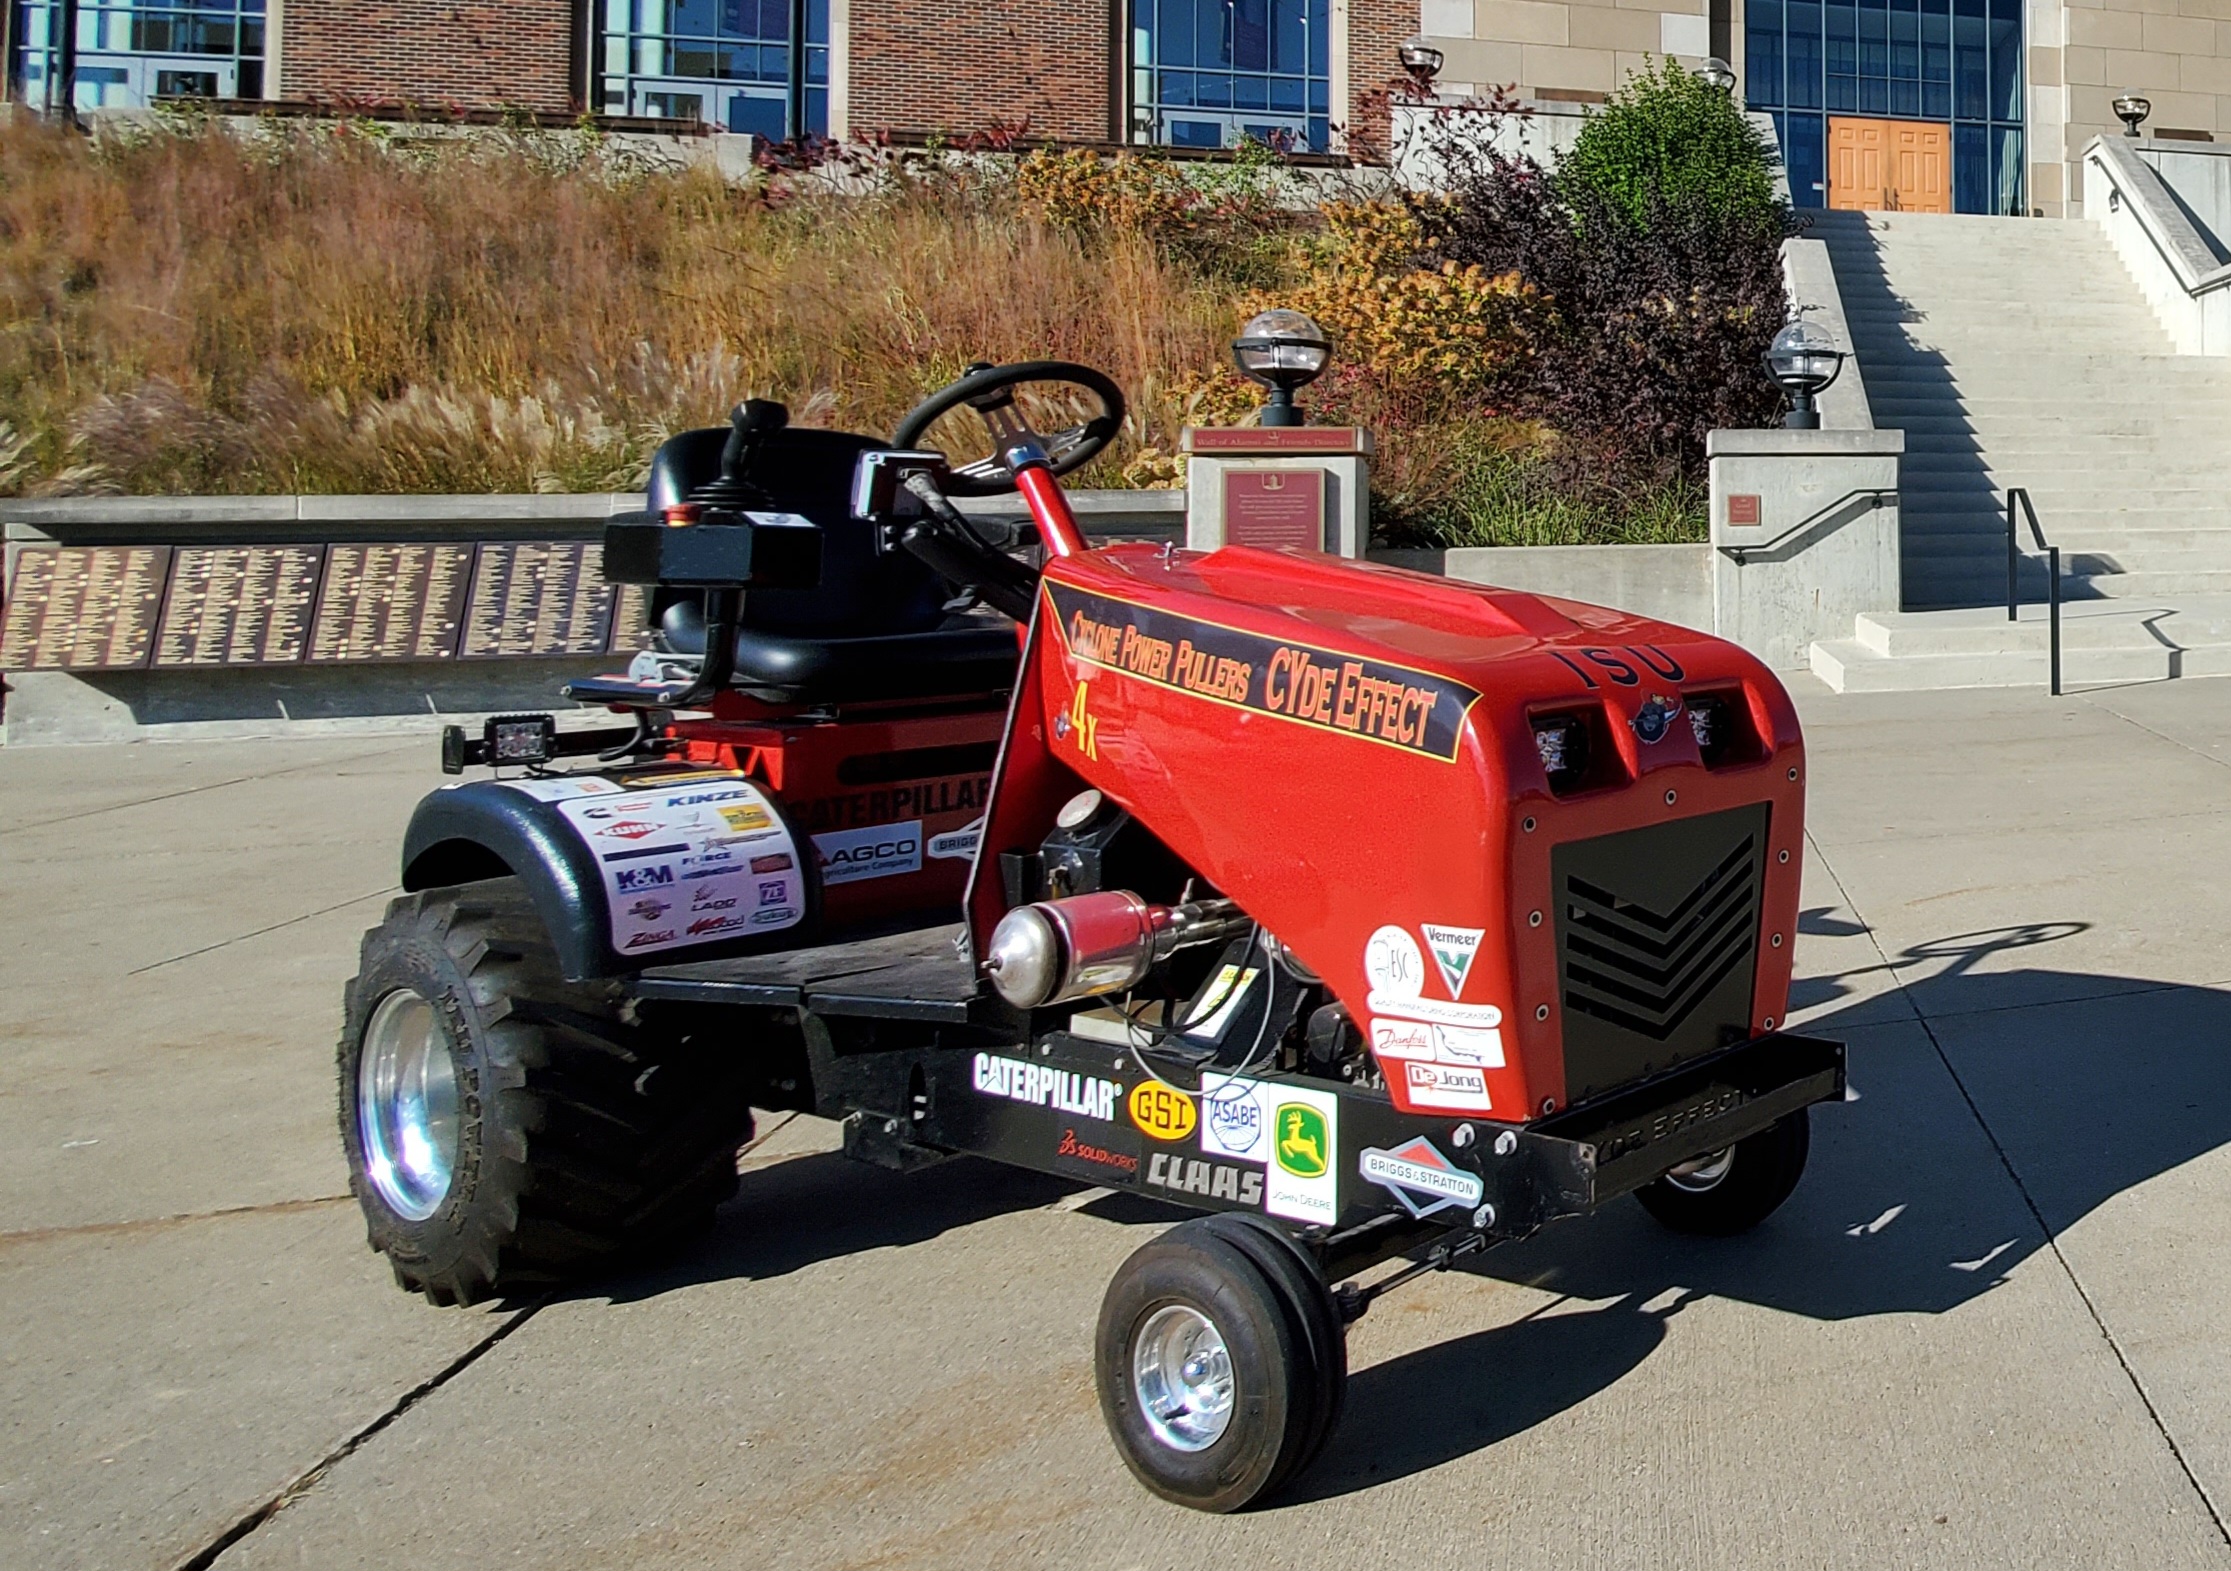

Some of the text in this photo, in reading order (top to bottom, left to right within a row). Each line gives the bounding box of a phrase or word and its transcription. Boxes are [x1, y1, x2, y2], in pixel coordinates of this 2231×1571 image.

[1071, 609, 1438, 747] CYCLONE POWER PULLERS CYDE EFFECT
[1547, 643, 1686, 690] ISU
[667, 789, 749, 807] KINZE
[831, 839, 916, 864] AGCO
[939, 836, 977, 850] BRIGG
[616, 865, 674, 889] K&M
[822, 858, 914, 880] griculture Company
[1428, 927, 1478, 946] Vermeer
[1377, 1028, 1428, 1049] Danfoss
[973, 1052, 1115, 1122] CATERPILLAR
[1409, 1066, 1436, 1085] De
[1137, 1090, 1187, 1130] GSI
[1212, 1101, 1258, 1128] ASABE
[1146, 1152, 1265, 1206] CLAAS
[1370, 1158, 1412, 1179] BRIGGS
[1420, 1171, 1474, 1195] STRATTON
[1299, 1194, 1331, 1210] DEERE
